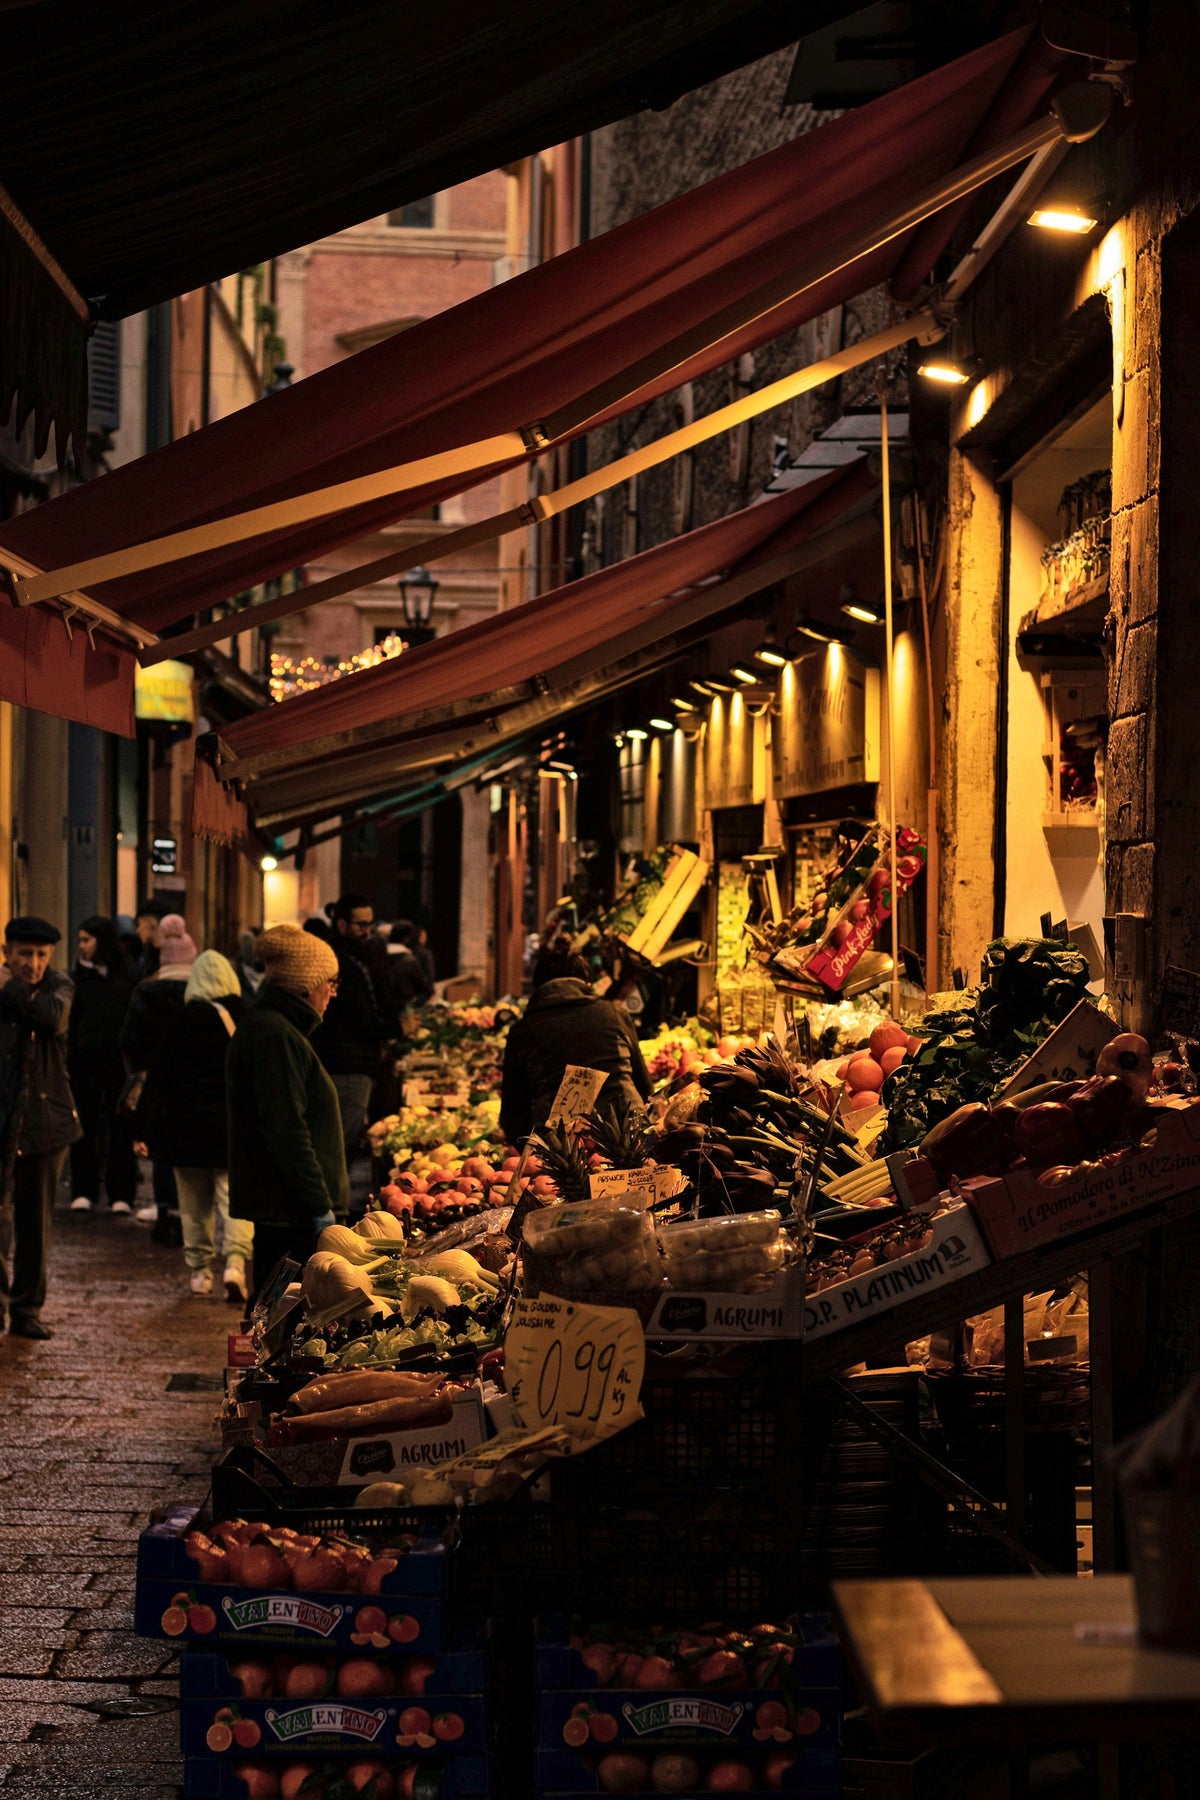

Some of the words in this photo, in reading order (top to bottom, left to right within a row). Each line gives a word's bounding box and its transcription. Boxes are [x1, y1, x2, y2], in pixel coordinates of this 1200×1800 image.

[830, 939, 859, 977] Pink
[855, 913, 880, 949] Lady
[1037, 1176, 1115, 1222] Pomodoro
[1118, 1166, 1136, 1186] di
[841, 1252, 945, 1313] PLATINUM
[530, 1301, 562, 1313] GOLDEN
[714, 1307, 783, 1332] AGRUMI
[617, 1367, 632, 1384] AL
[401, 1438, 466, 1466] AGRUMI
[234, 1600, 333, 1629] VALENTINO
[277, 1709, 377, 1735] VALENTINO
[634, 1703, 735, 1729] VALENTINO
